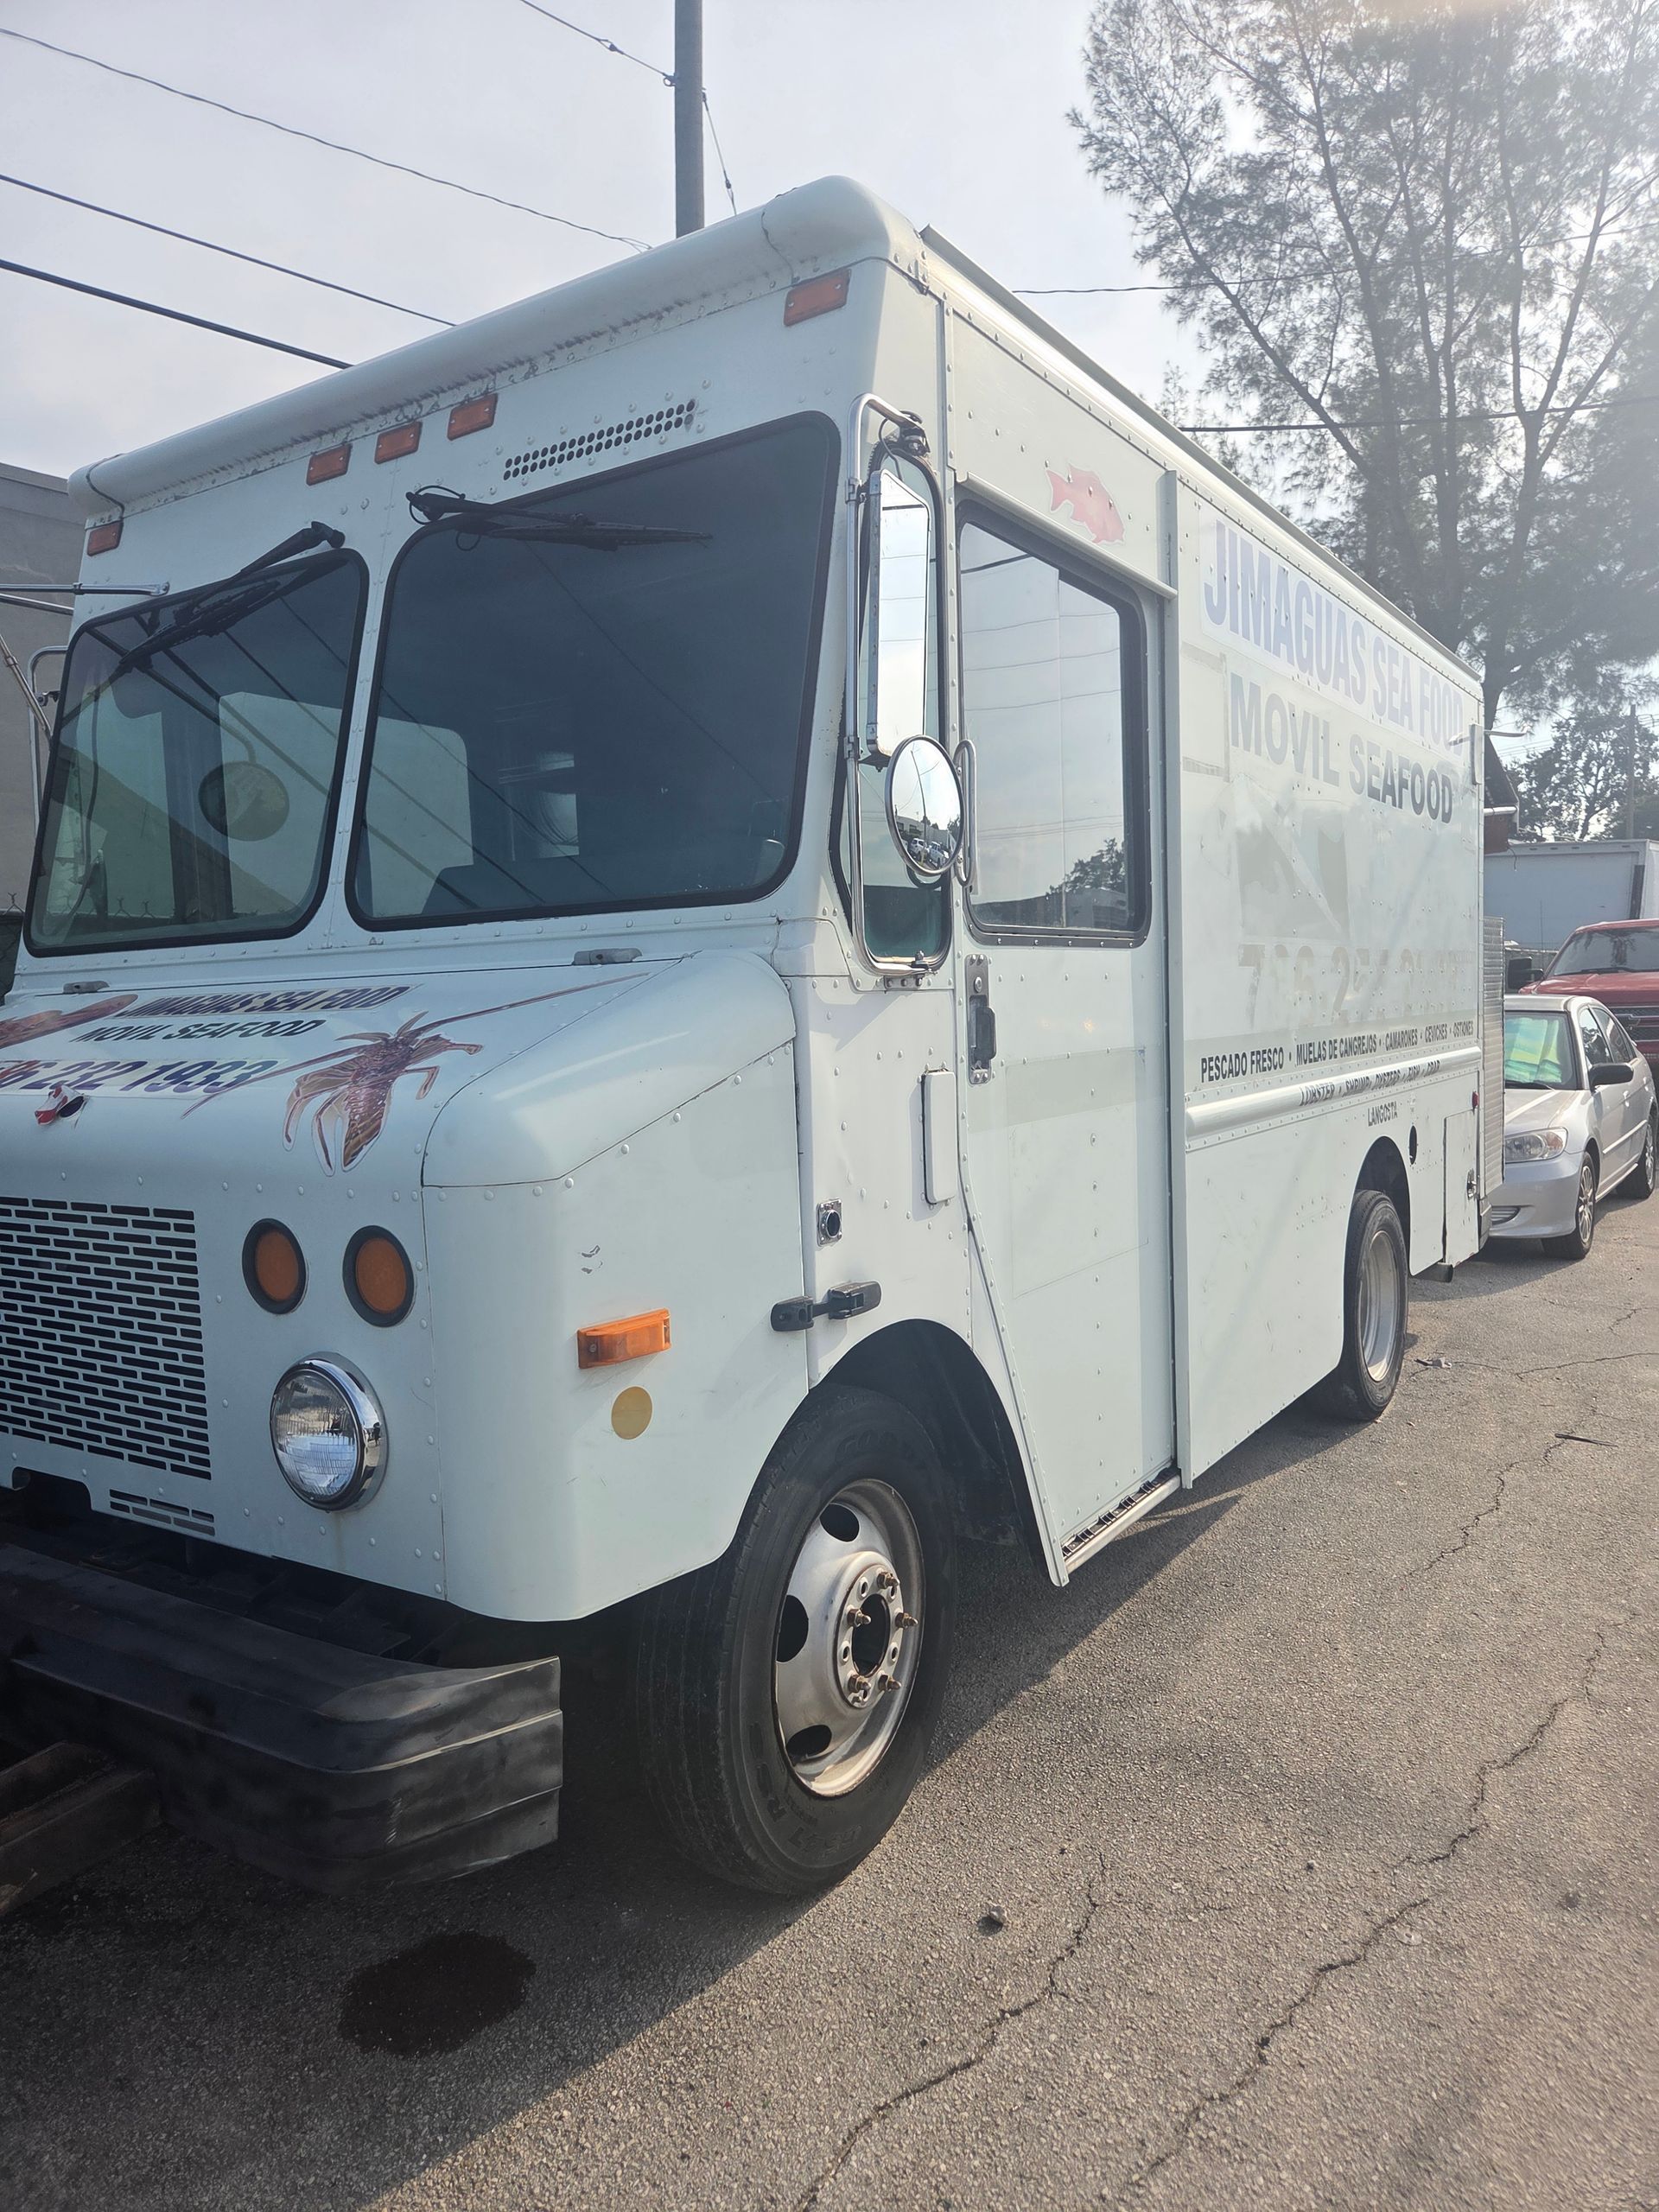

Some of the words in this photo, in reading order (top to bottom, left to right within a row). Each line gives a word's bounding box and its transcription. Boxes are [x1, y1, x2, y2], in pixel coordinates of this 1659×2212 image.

[1204, 519, 1366, 706] JIMAGUAS
[1372, 634, 1414, 731] SEA
[1420, 666, 1463, 756] FOOD
[1230, 672, 1339, 787] MOVIL
[1349, 734, 1452, 823] SEAFOOD
[245, 990, 328, 1012] SEA
[303, 987, 410, 1009] FOOD
[69, 1025, 173, 1042] MOVIL
[162, 1019, 327, 1040] SEAFOOD
[1201, 1052, 1247, 1083] PESCADO
[1250, 1046, 1284, 1074] FRESCO
[1296, 1041, 1327, 1065] MUELAS
[1329, 1039, 1338, 1059] DE
[1339, 1034, 1377, 1058] CANGREJOS
[1385, 1028, 1418, 1052] CAMARONES
[1426, 1023, 1448, 1042] CEVICHES
[1453, 1020, 1474, 1039] OSTIONES
[19, 1061, 147, 1090] 232
[120, 1060, 278, 1093] 1933
[1300, 1082, 1336, 1106] LOBSTER
[1368, 1101, 1398, 1127] LANGOSTA
